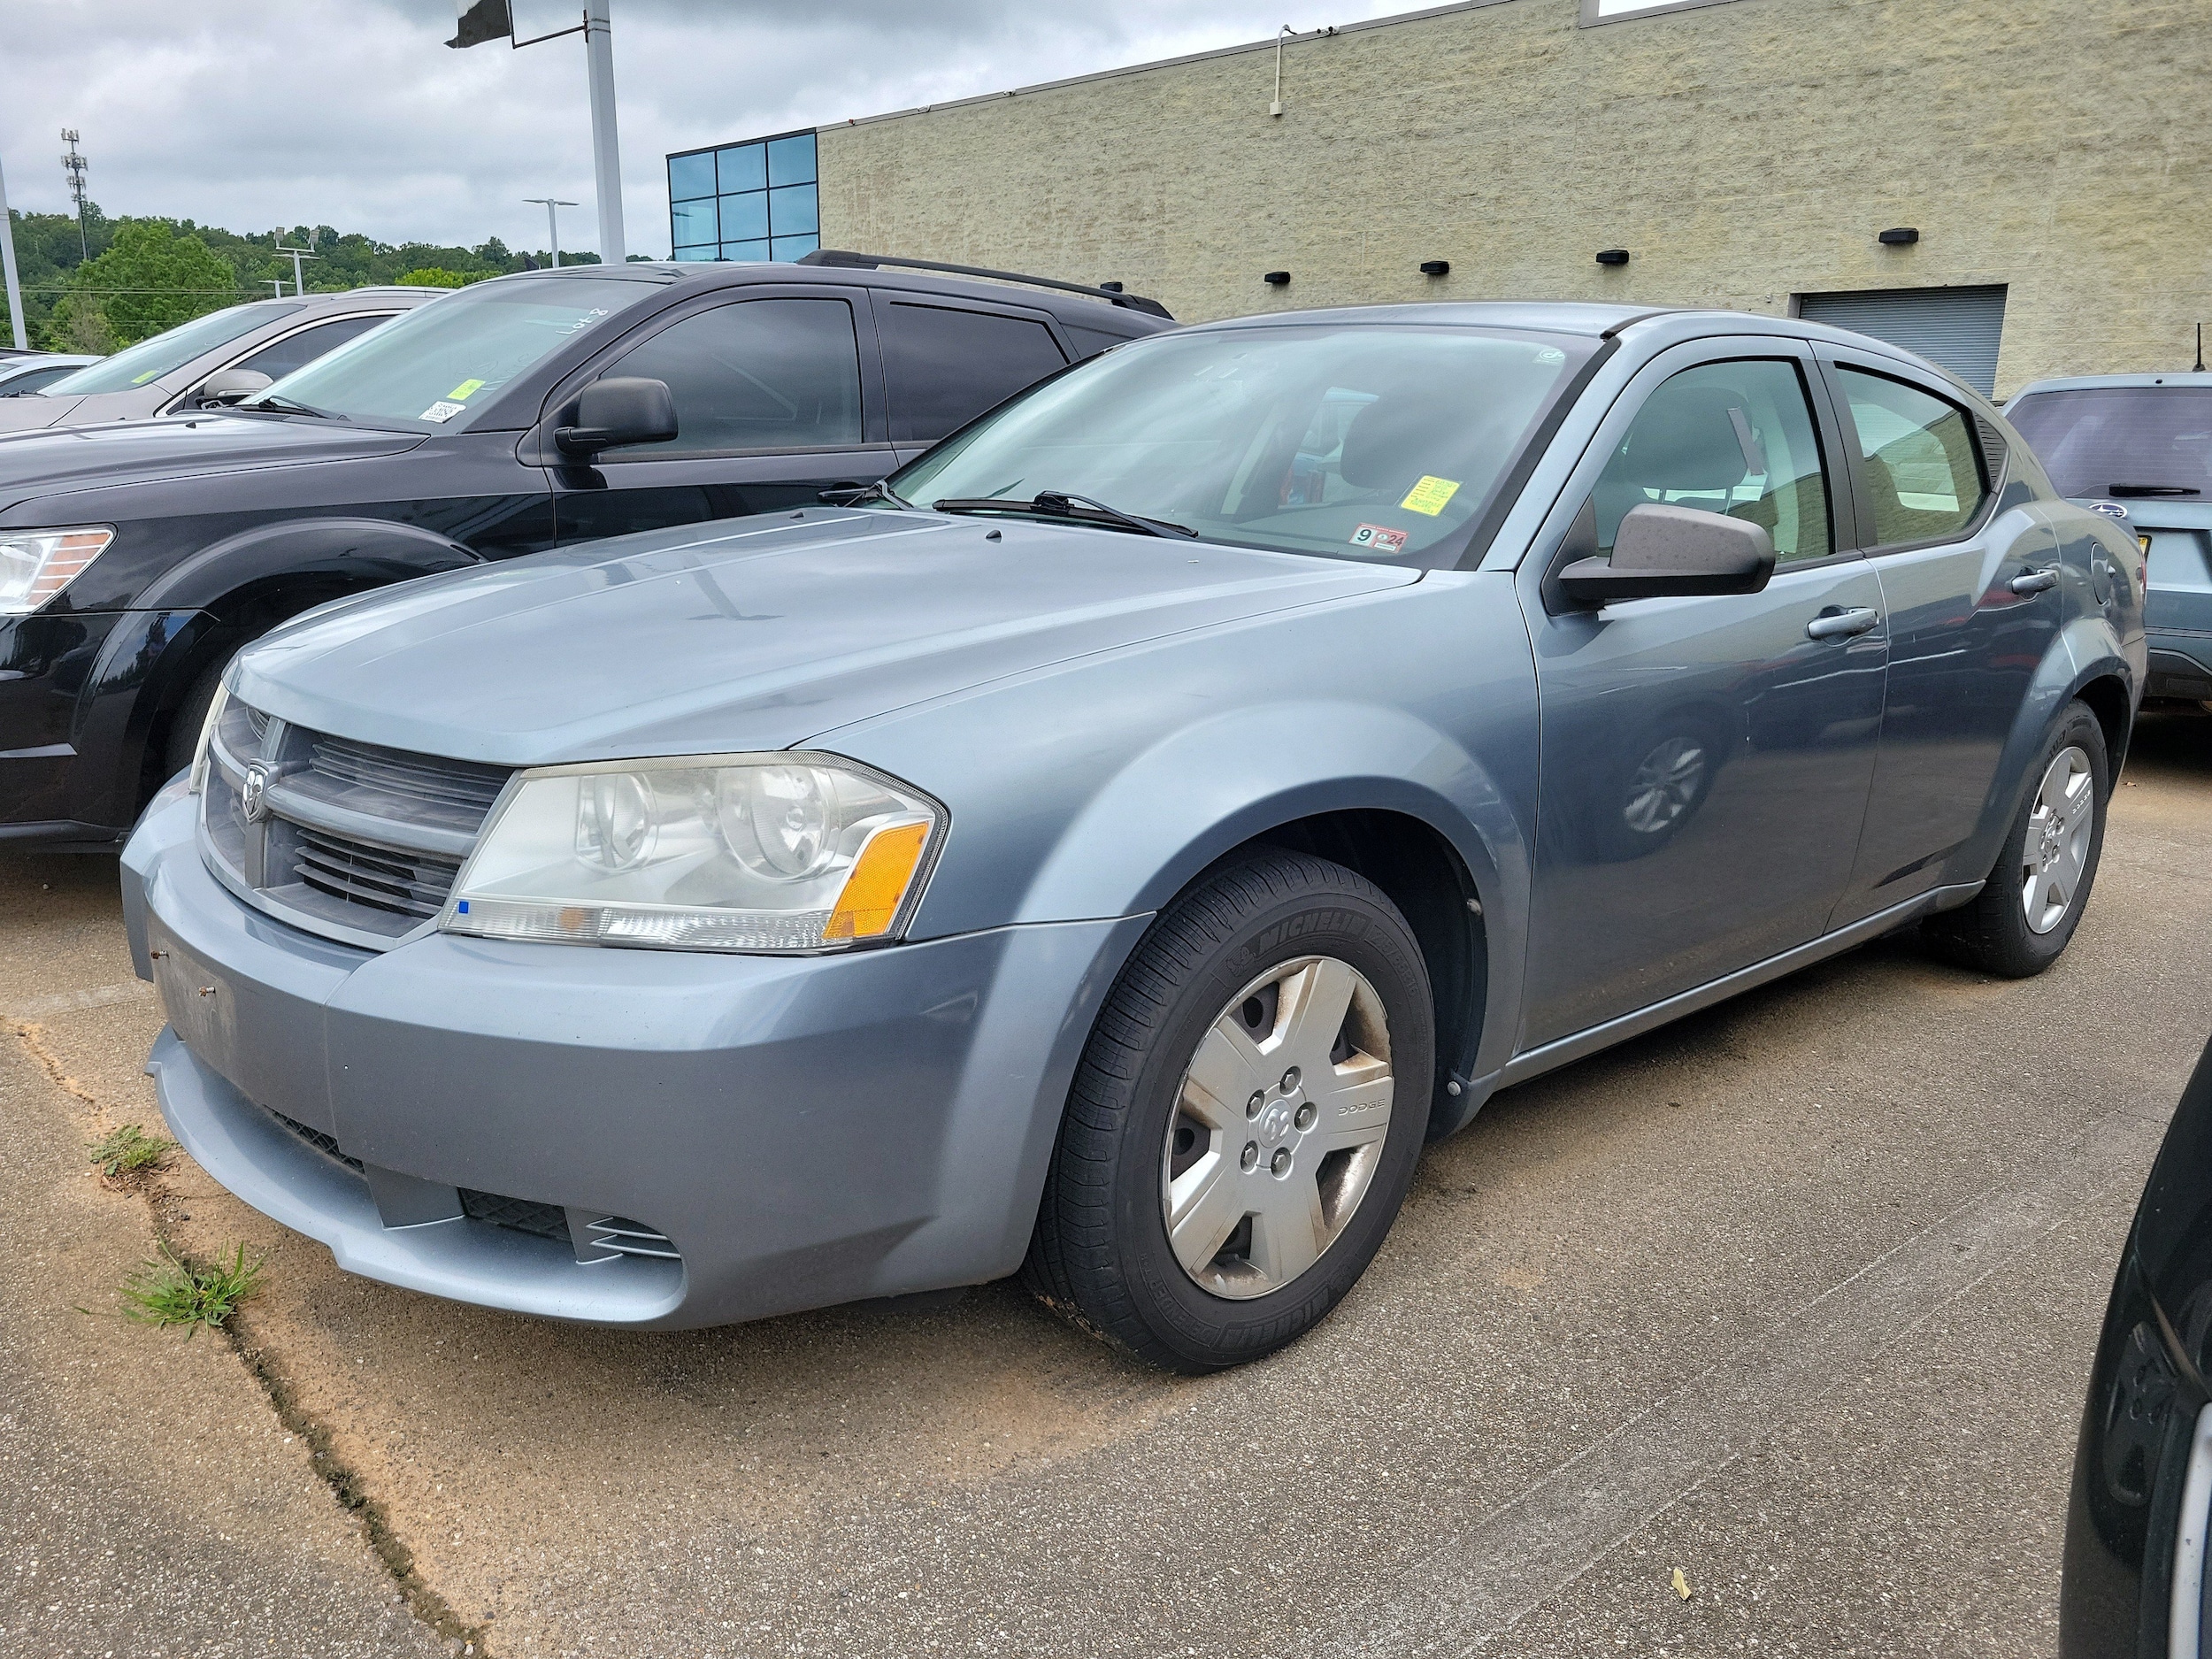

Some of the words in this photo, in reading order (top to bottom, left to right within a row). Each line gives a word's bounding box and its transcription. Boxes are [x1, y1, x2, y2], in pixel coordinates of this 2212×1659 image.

[556, 317, 592, 334] Lot
[1356, 528, 1372, 541] 9
[1386, 534, 1404, 546] 24
[1258, 911, 1367, 955] MICHELIN
[1338, 1098, 1386, 1116] DODGE
[1221, 1287, 1330, 1348] MICHELIN
